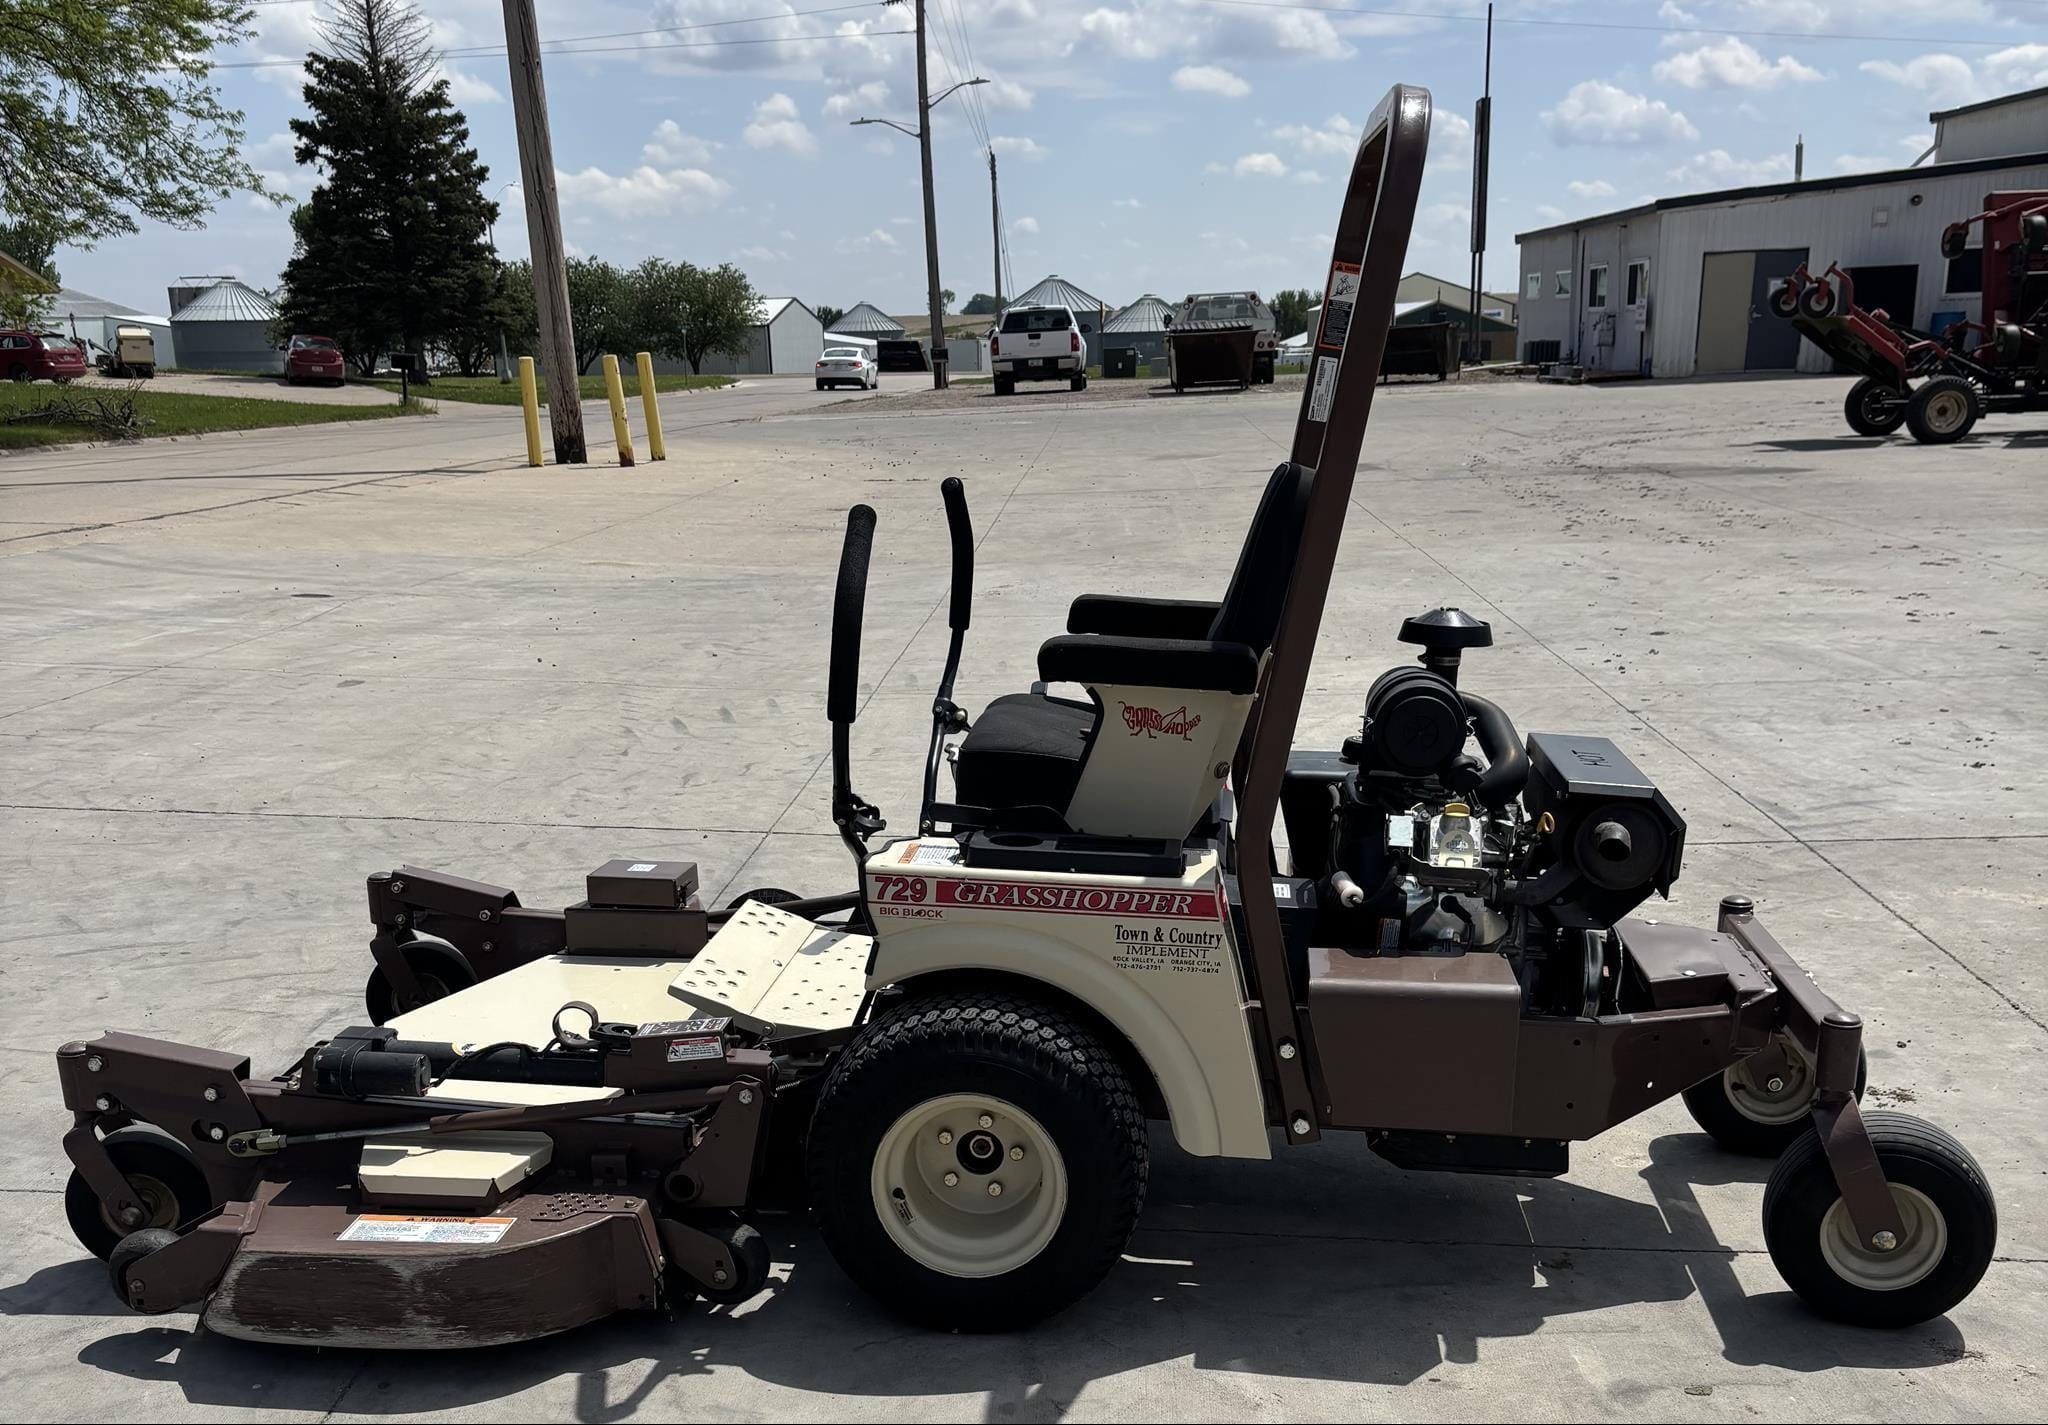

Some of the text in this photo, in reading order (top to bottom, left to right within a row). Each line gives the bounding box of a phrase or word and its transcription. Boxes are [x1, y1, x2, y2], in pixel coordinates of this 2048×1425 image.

[874, 876, 928, 903] 729
[953, 882, 1193, 915] GRASSHOPPER
[879, 906, 943, 918] BIG BLOCK
[1114, 924, 1223, 950] Town & Country
[1126, 944, 1210, 959] IMPLEMENT
